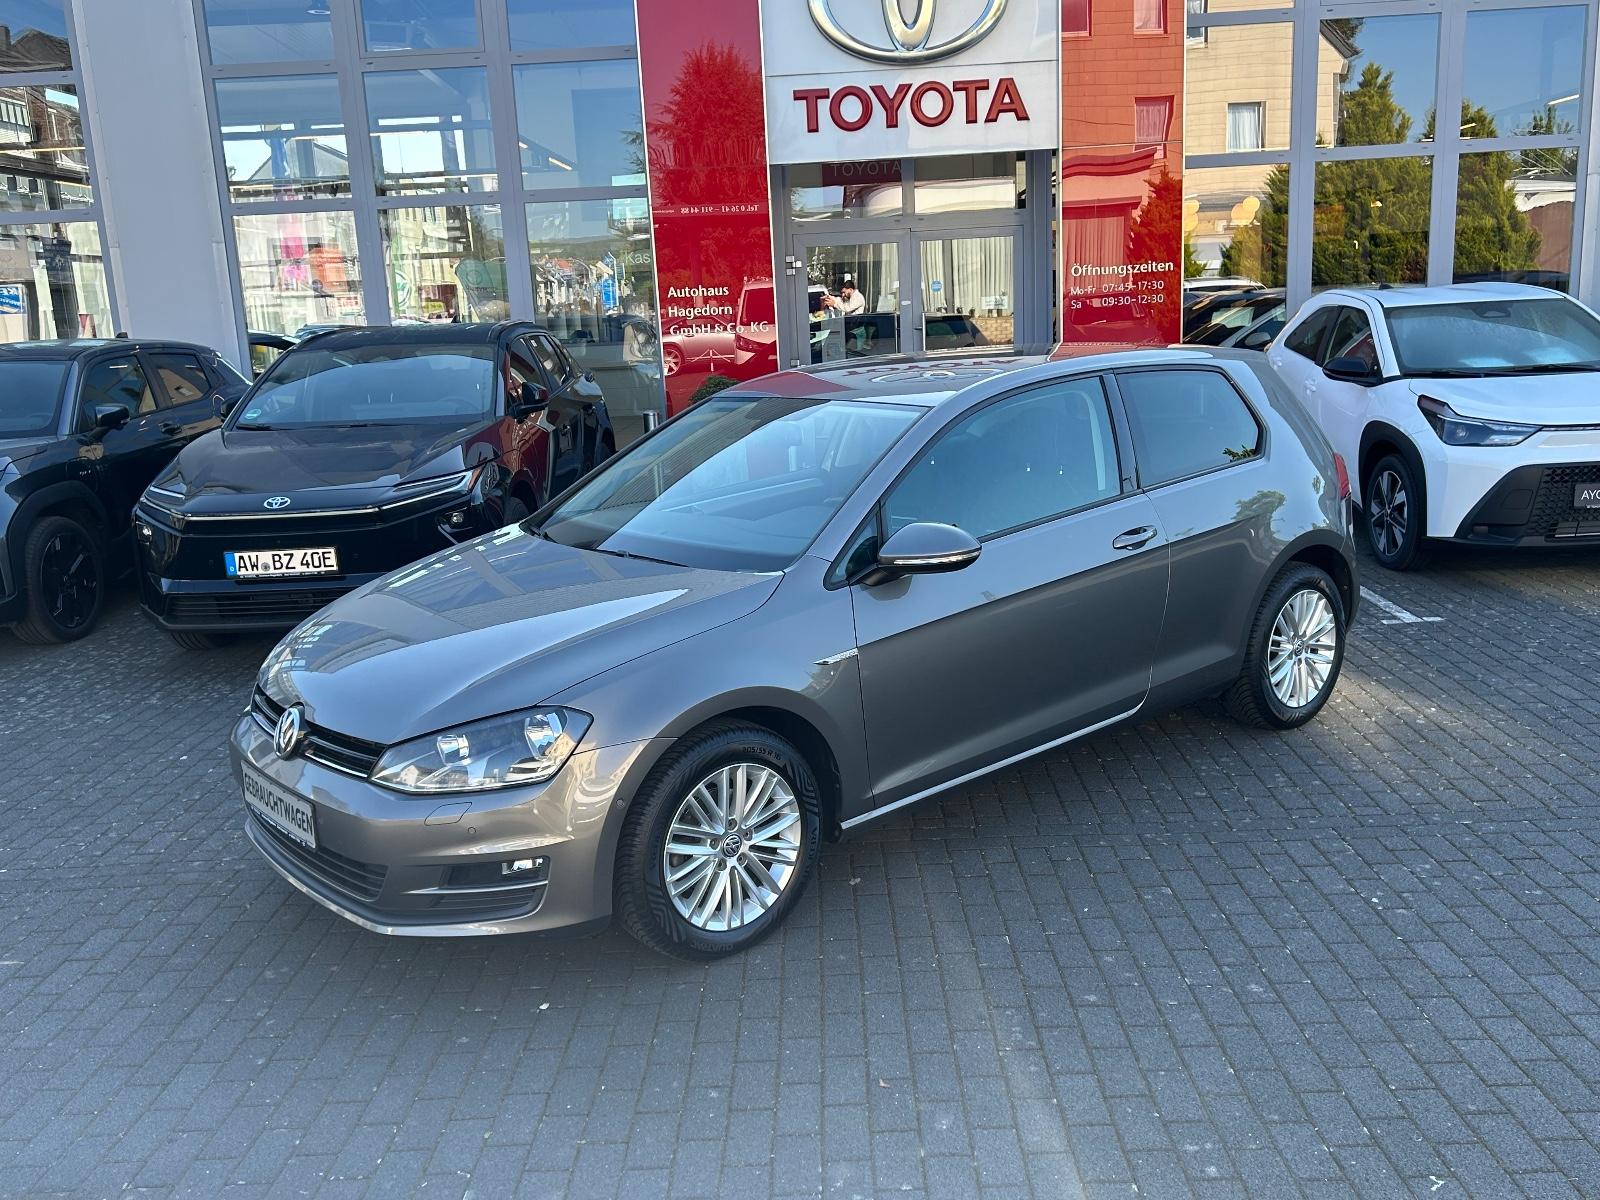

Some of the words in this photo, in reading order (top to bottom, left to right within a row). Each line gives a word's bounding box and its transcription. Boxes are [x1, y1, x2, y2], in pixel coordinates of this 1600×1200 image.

[793, 77, 1030, 133] TOYOTA
[830, 161, 901, 177] TOYOTA
[1071, 260, 1174, 277] Öffnungszeiten
[668, 285, 729, 298] Autohaus
[1070, 285, 1096, 296] Mo-Fr
[1070, 300, 1082, 309] Sa
[1102, 294, 1164, 306] 09:30-12:30
[668, 304, 733, 320] Hagedorn
[670, 323, 711, 336] GmbH
[714, 323, 724, 334] &
[751, 321, 769, 333] KG
[238, 554, 259, 572] AW
[272, 552, 296, 570] BZ
[300, 551, 335, 569] 40E
[244, 772, 314, 836] GEBRAUCHTWAGEN
